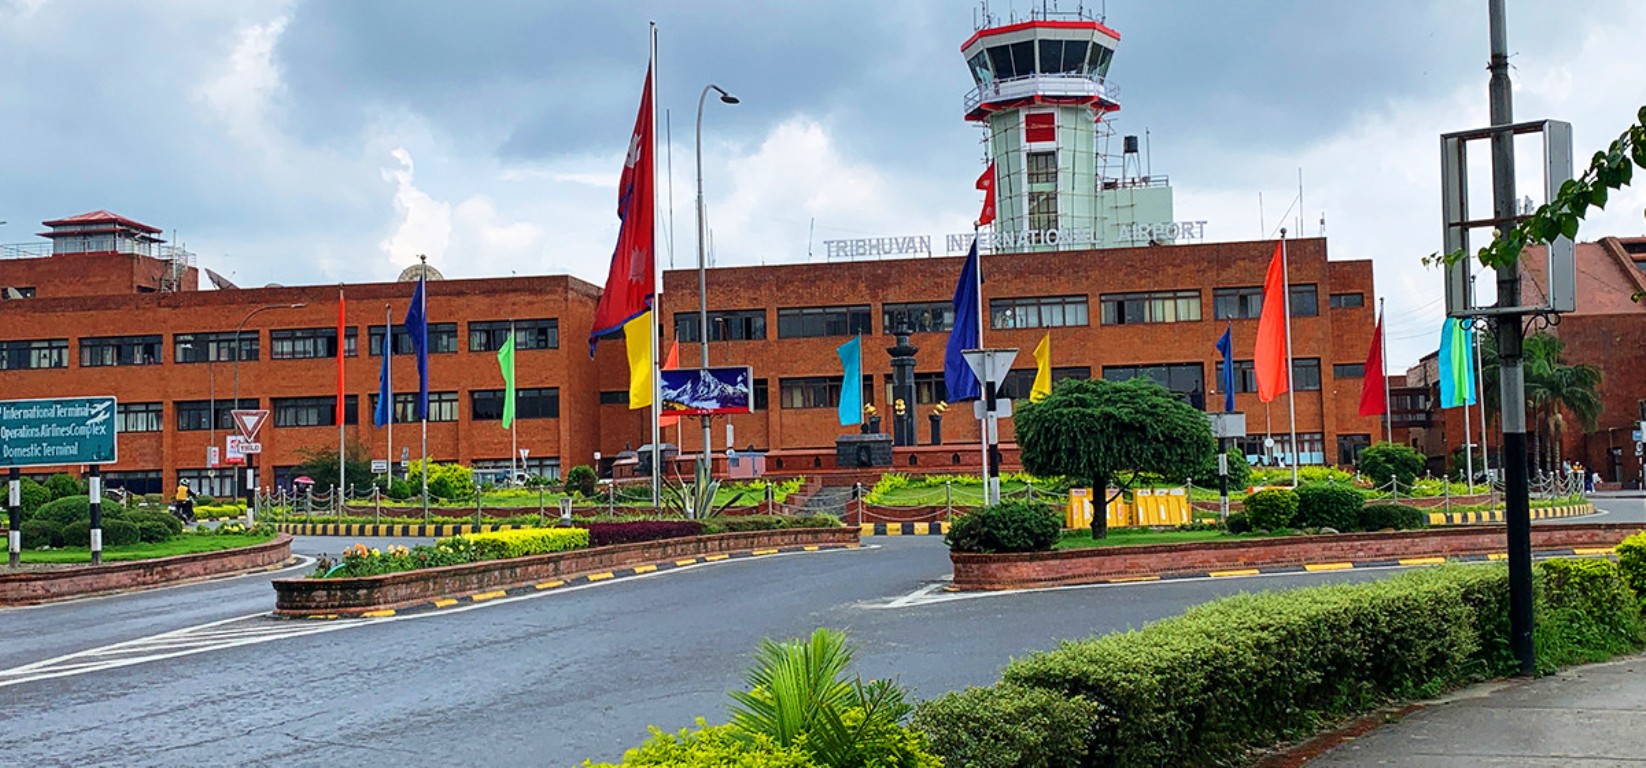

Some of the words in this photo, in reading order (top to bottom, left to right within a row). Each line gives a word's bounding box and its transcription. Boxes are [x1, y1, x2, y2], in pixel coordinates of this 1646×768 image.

[823, 235, 931, 257] TRIBHUVAN
[1118, 221, 1208, 241] AIRPORT
[3, 404, 55, 419] International
[56, 403, 89, 418] Terminal
[1, 424, 40, 441] Operations
[4, 443, 42, 457] Domestic
[42, 441, 78, 456] Terminal
